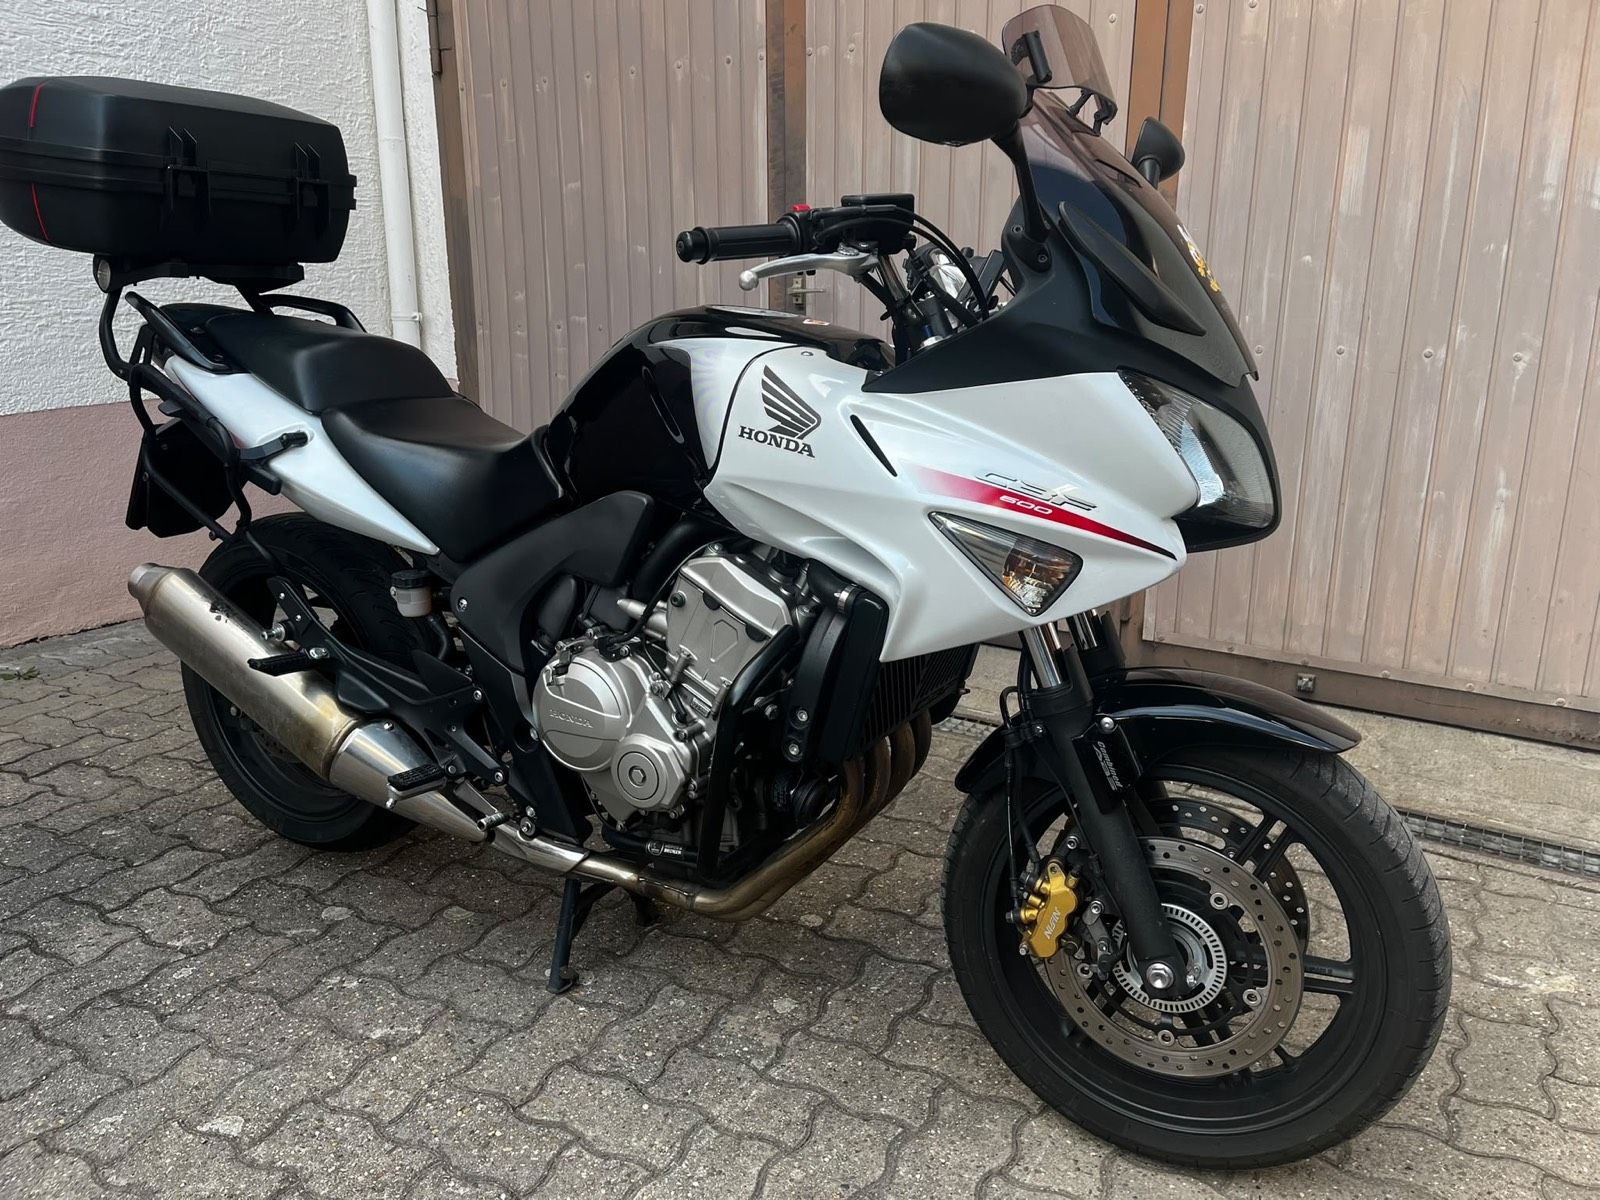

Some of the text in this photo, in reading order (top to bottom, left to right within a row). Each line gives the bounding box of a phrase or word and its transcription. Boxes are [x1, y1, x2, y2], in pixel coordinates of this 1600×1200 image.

[738, 425, 815, 458] HONDA
[975, 472, 1097, 511] CBF
[999, 495, 1053, 515] 600
[549, 709, 594, 729] HONDA
[1097, 740, 1123, 788] Combined
